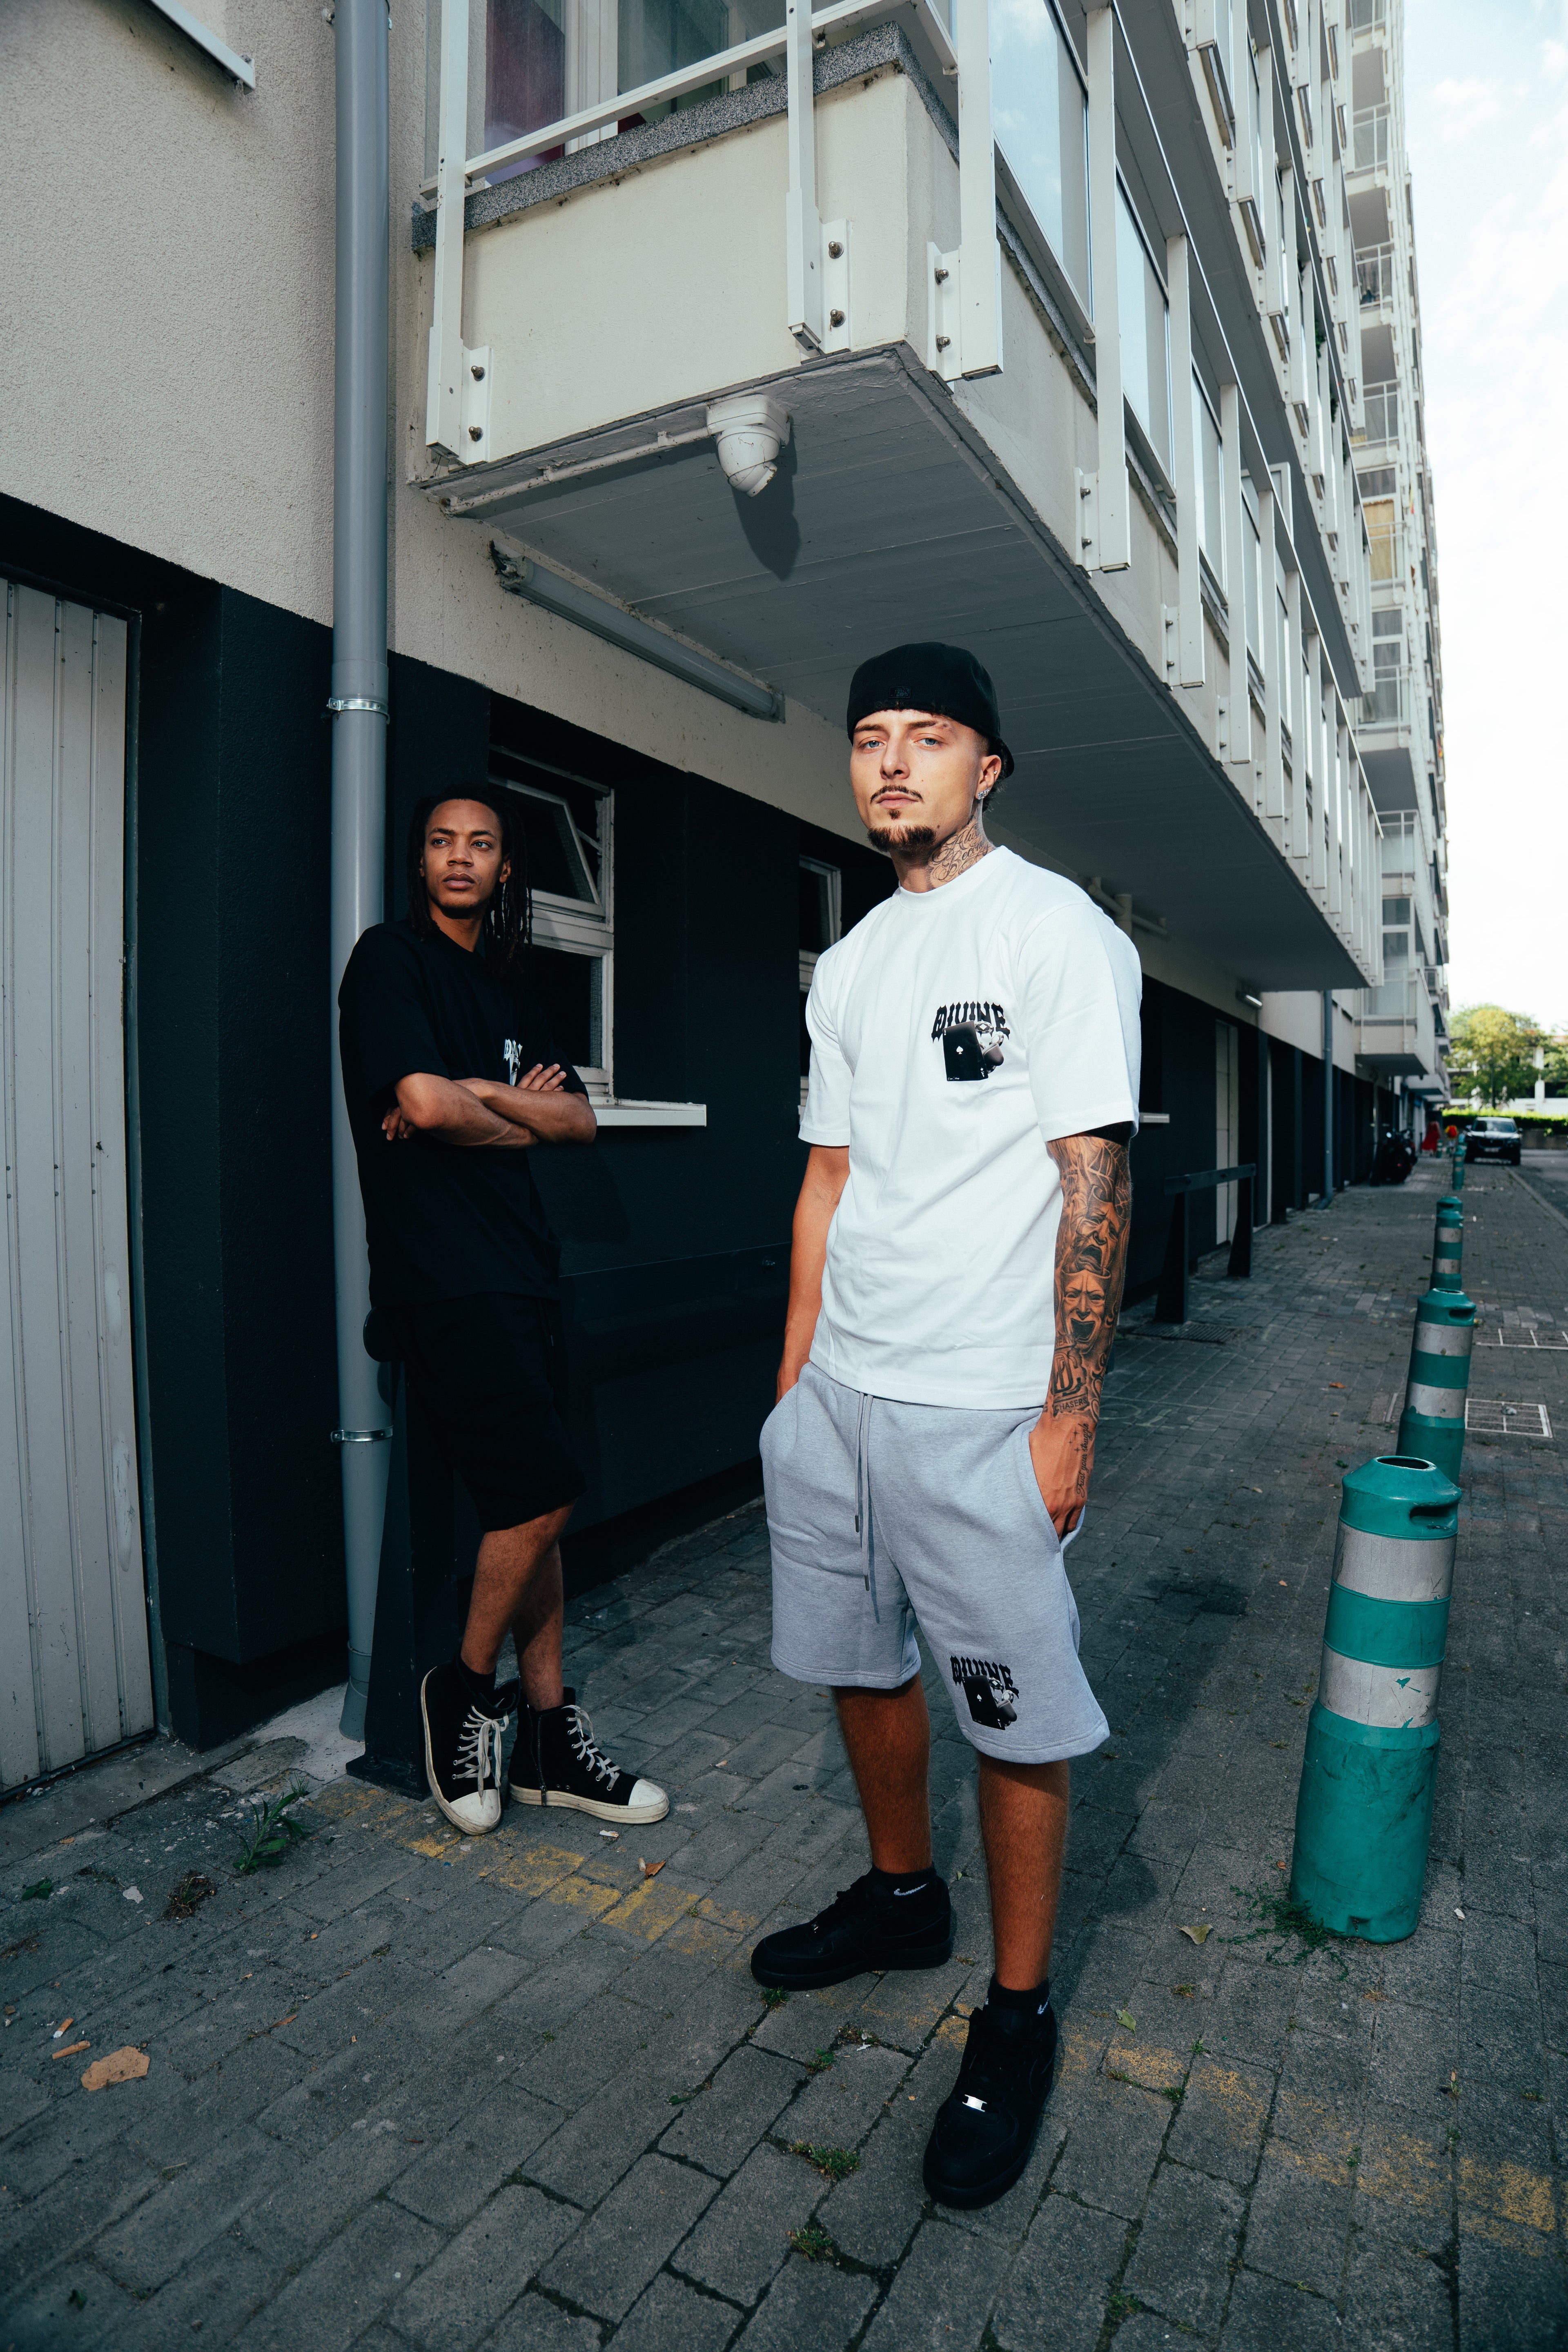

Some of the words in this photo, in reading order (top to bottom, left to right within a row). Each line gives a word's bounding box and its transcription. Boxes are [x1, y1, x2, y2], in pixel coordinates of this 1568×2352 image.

[931, 1001, 1010, 1043] DIVINE
[1055, 1398, 1087, 1410] CHASERS
[1078, 1423, 1093, 1452] struggle
[1081, 1454, 1089, 1473] your
[1076, 1470, 1085, 1498] Trust
[950, 1655, 1019, 1699] DIVINE
